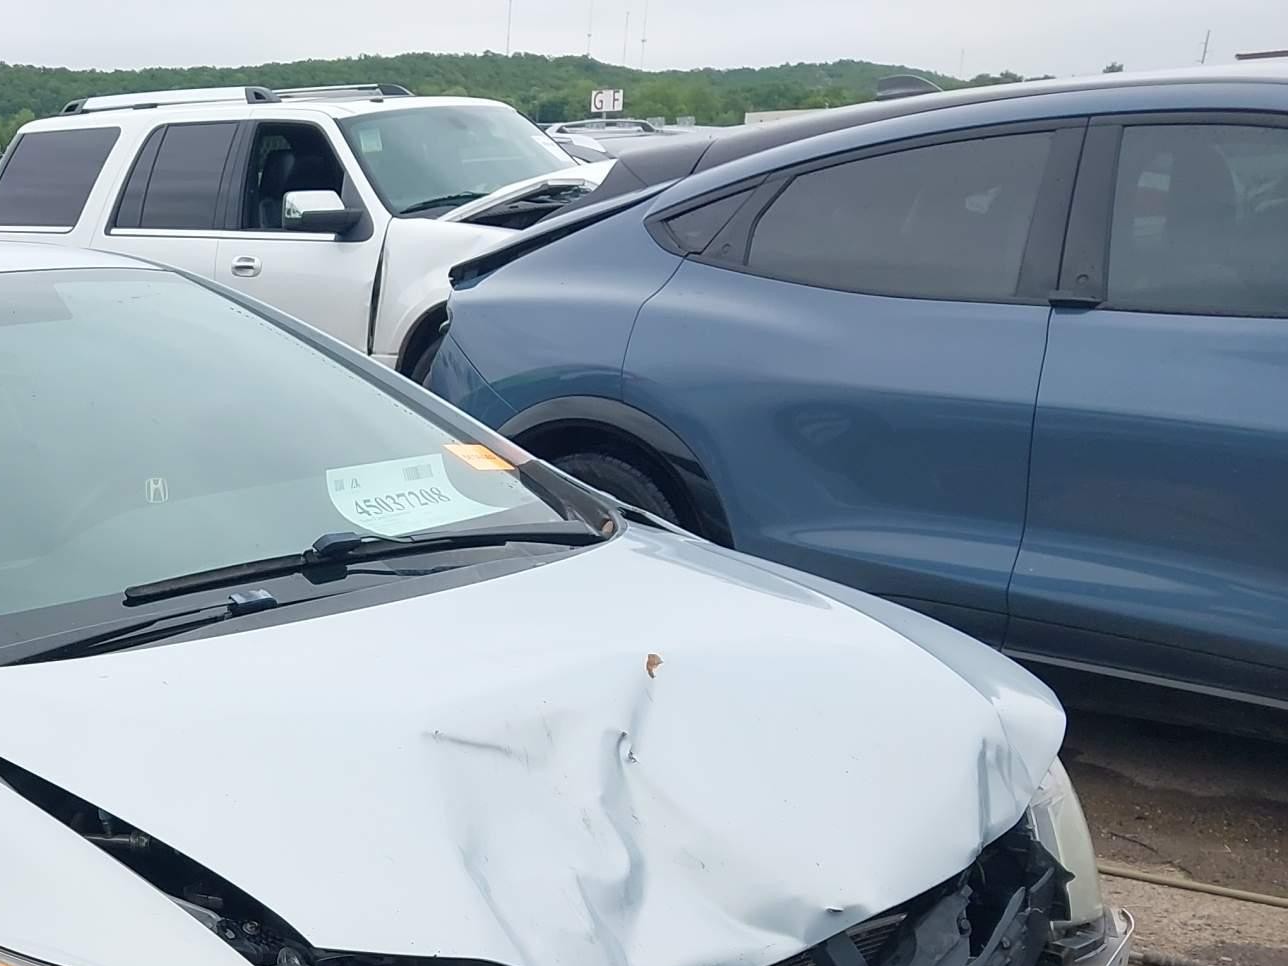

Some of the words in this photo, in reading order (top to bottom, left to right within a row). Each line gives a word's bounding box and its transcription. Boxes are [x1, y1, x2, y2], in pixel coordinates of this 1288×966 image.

[593, 91, 603, 111] G
[612, 90, 620, 110] F
[354, 486, 451, 517] 45037208
